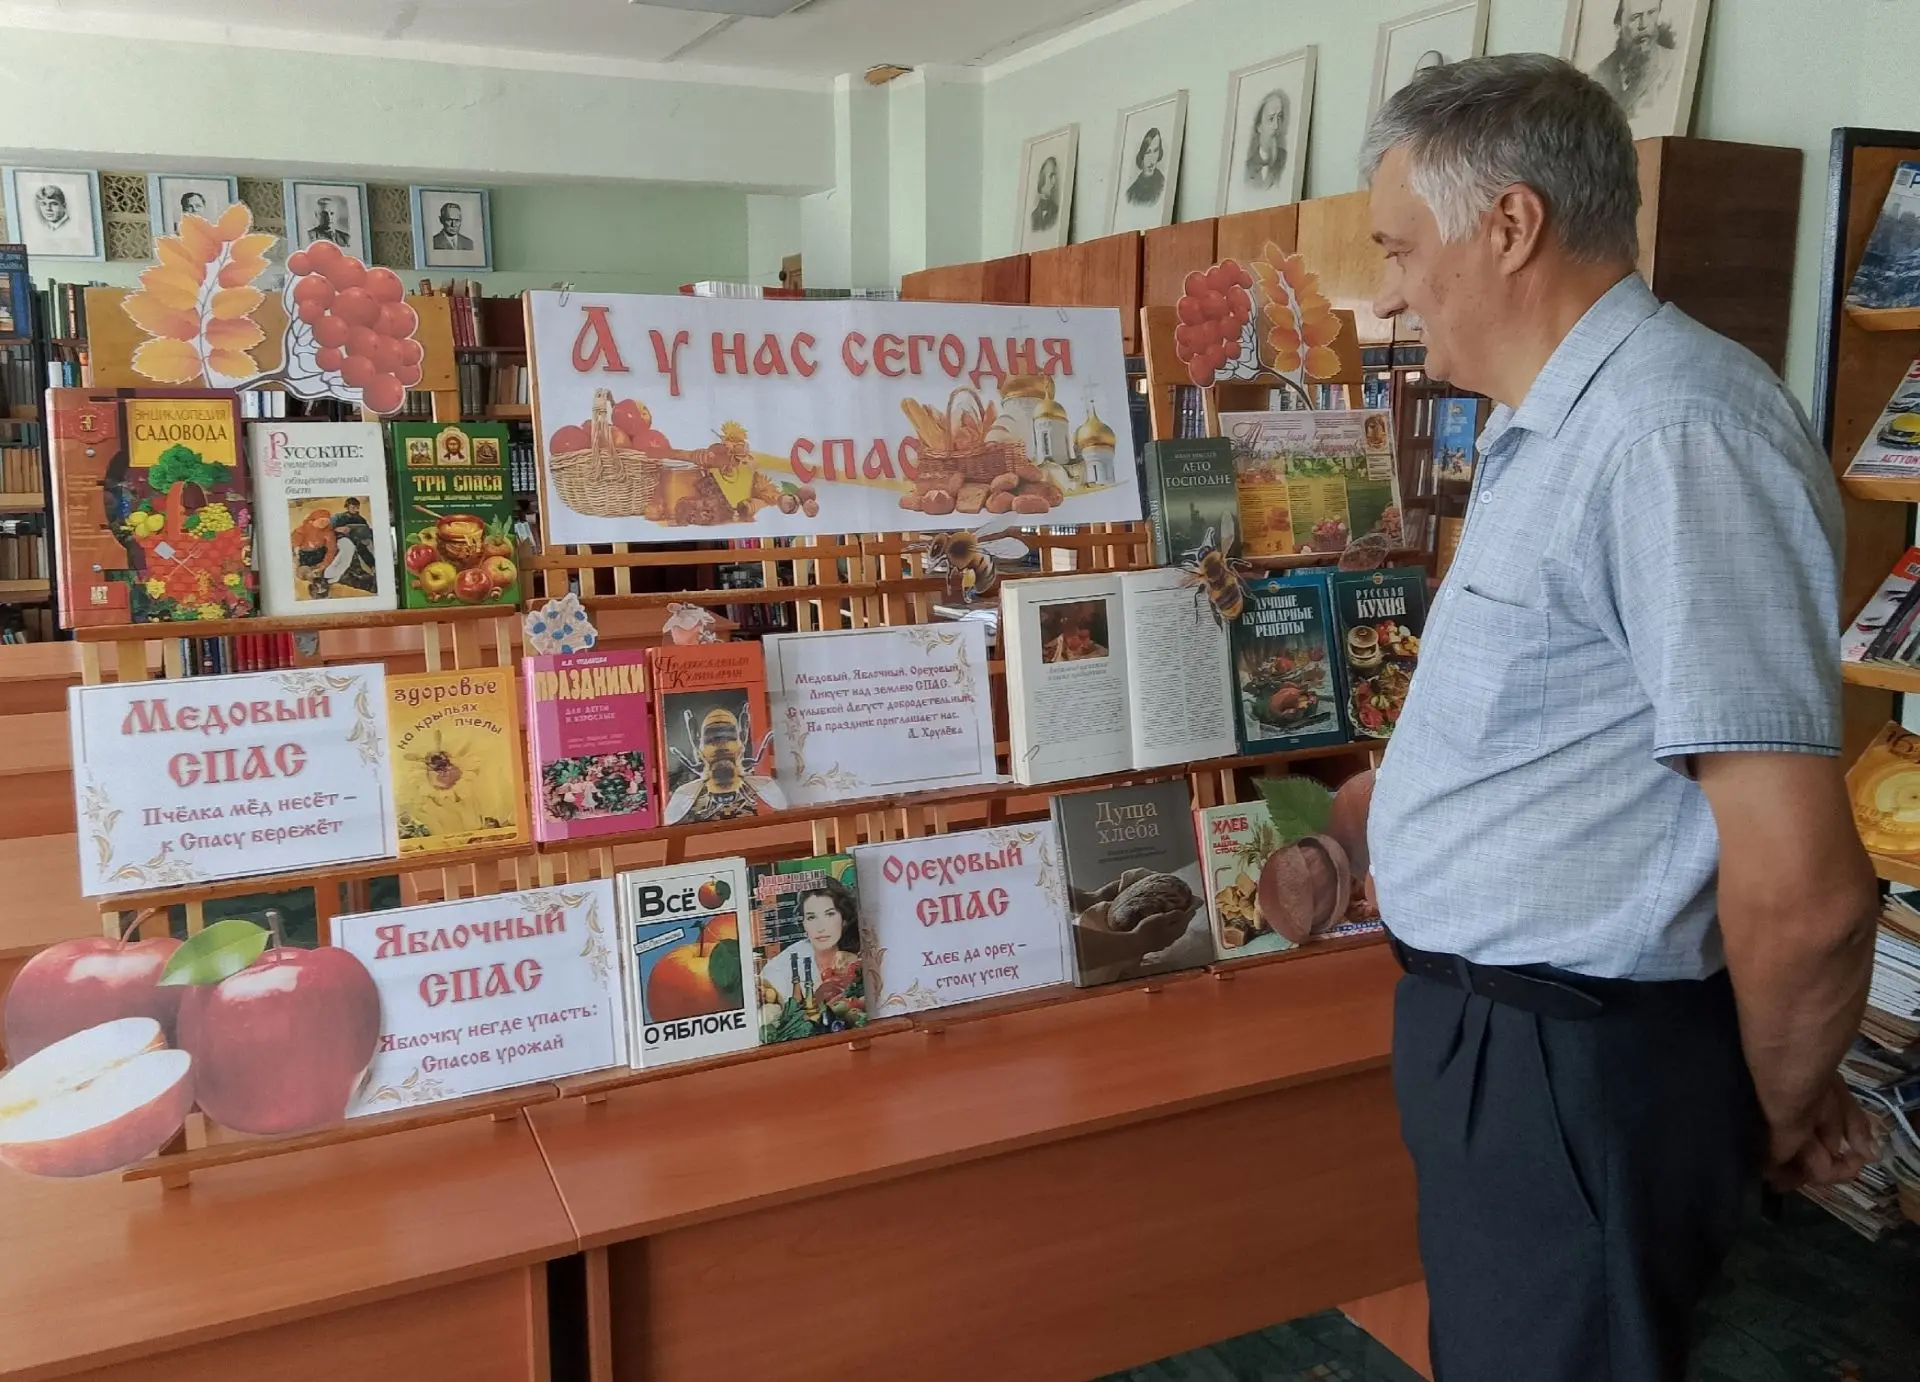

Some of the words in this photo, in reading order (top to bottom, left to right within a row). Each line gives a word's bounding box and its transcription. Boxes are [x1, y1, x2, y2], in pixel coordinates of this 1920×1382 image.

[572, 306, 630, 373] А
[648, 329, 689, 397] у
[711, 331, 818, 378] нас
[841, 331, 1074, 390] сегодня
[134, 408, 227, 421] ЭНЦИКЛОПЕДИЯ
[134, 424, 228, 443] САДОВОДА
[1183, 461, 1211, 474] ЛЕТО
[412, 475, 446, 492] ТРИ
[453, 475, 503, 492] СПАСА
[1165, 474, 1231, 488] ГОСПОДНЕ
[1255, 594, 1298, 611] ЛУЧШИЕ
[1356, 586, 1404, 599] РУССКАЯ
[1242, 606, 1314, 626] КУЛИНАРНЫЕ
[1357, 596, 1407, 618] КУХНЯ
[1255, 621, 1304, 639] РЕЦЕПТЫ
[394, 677, 497, 706] здоровье
[535, 664, 645, 702] ПРАЗДНИКИ
[810, 688, 849, 700] Ликует
[852, 687, 871, 697] над
[121, 688, 331, 736] Медовый
[799, 702, 843, 719] улыбкой
[846, 702, 884, 714] Август
[806, 721, 822, 733] На
[825, 718, 875, 734] праздник
[876, 713, 939, 729] приглашает
[940, 711, 960, 720] нас.
[397, 732, 414, 750] на
[414, 703, 478, 732] крыльях
[455, 718, 503, 734] пчелы
[168, 742, 308, 787] СПАС
[142, 803, 223, 827] Пчёлка
[229, 799, 273, 816] мёд
[278, 792, 339, 812] несёт
[1095, 801, 1158, 829] Душа
[179, 829, 246, 850] Спасу
[251, 819, 343, 845] бережёт
[1098, 818, 1161, 844] хлеба
[1212, 816, 1249, 834] ХЛЕБ
[883, 840, 1023, 891] Ореховый
[916, 887, 1010, 928] СПАС
[374, 906, 566, 960] Яблочный
[922, 951, 960, 967] Хлеб
[964, 946, 981, 963] да
[985, 942, 1015, 960] орех
[419, 958, 543, 1008] СПАС
[936, 972, 978, 989] столу
[979, 964, 1020, 985] успех
[379, 1025, 463, 1053] Яблочку
[468, 1017, 523, 1037] негде
[529, 1003, 598, 1033] упасть:
[644, 1027, 660, 1044] О
[663, 1012, 747, 1042] ЯБЛОКЕ
[422, 1050, 491, 1074] Спасов
[497, 1034, 564, 1064] урожай
